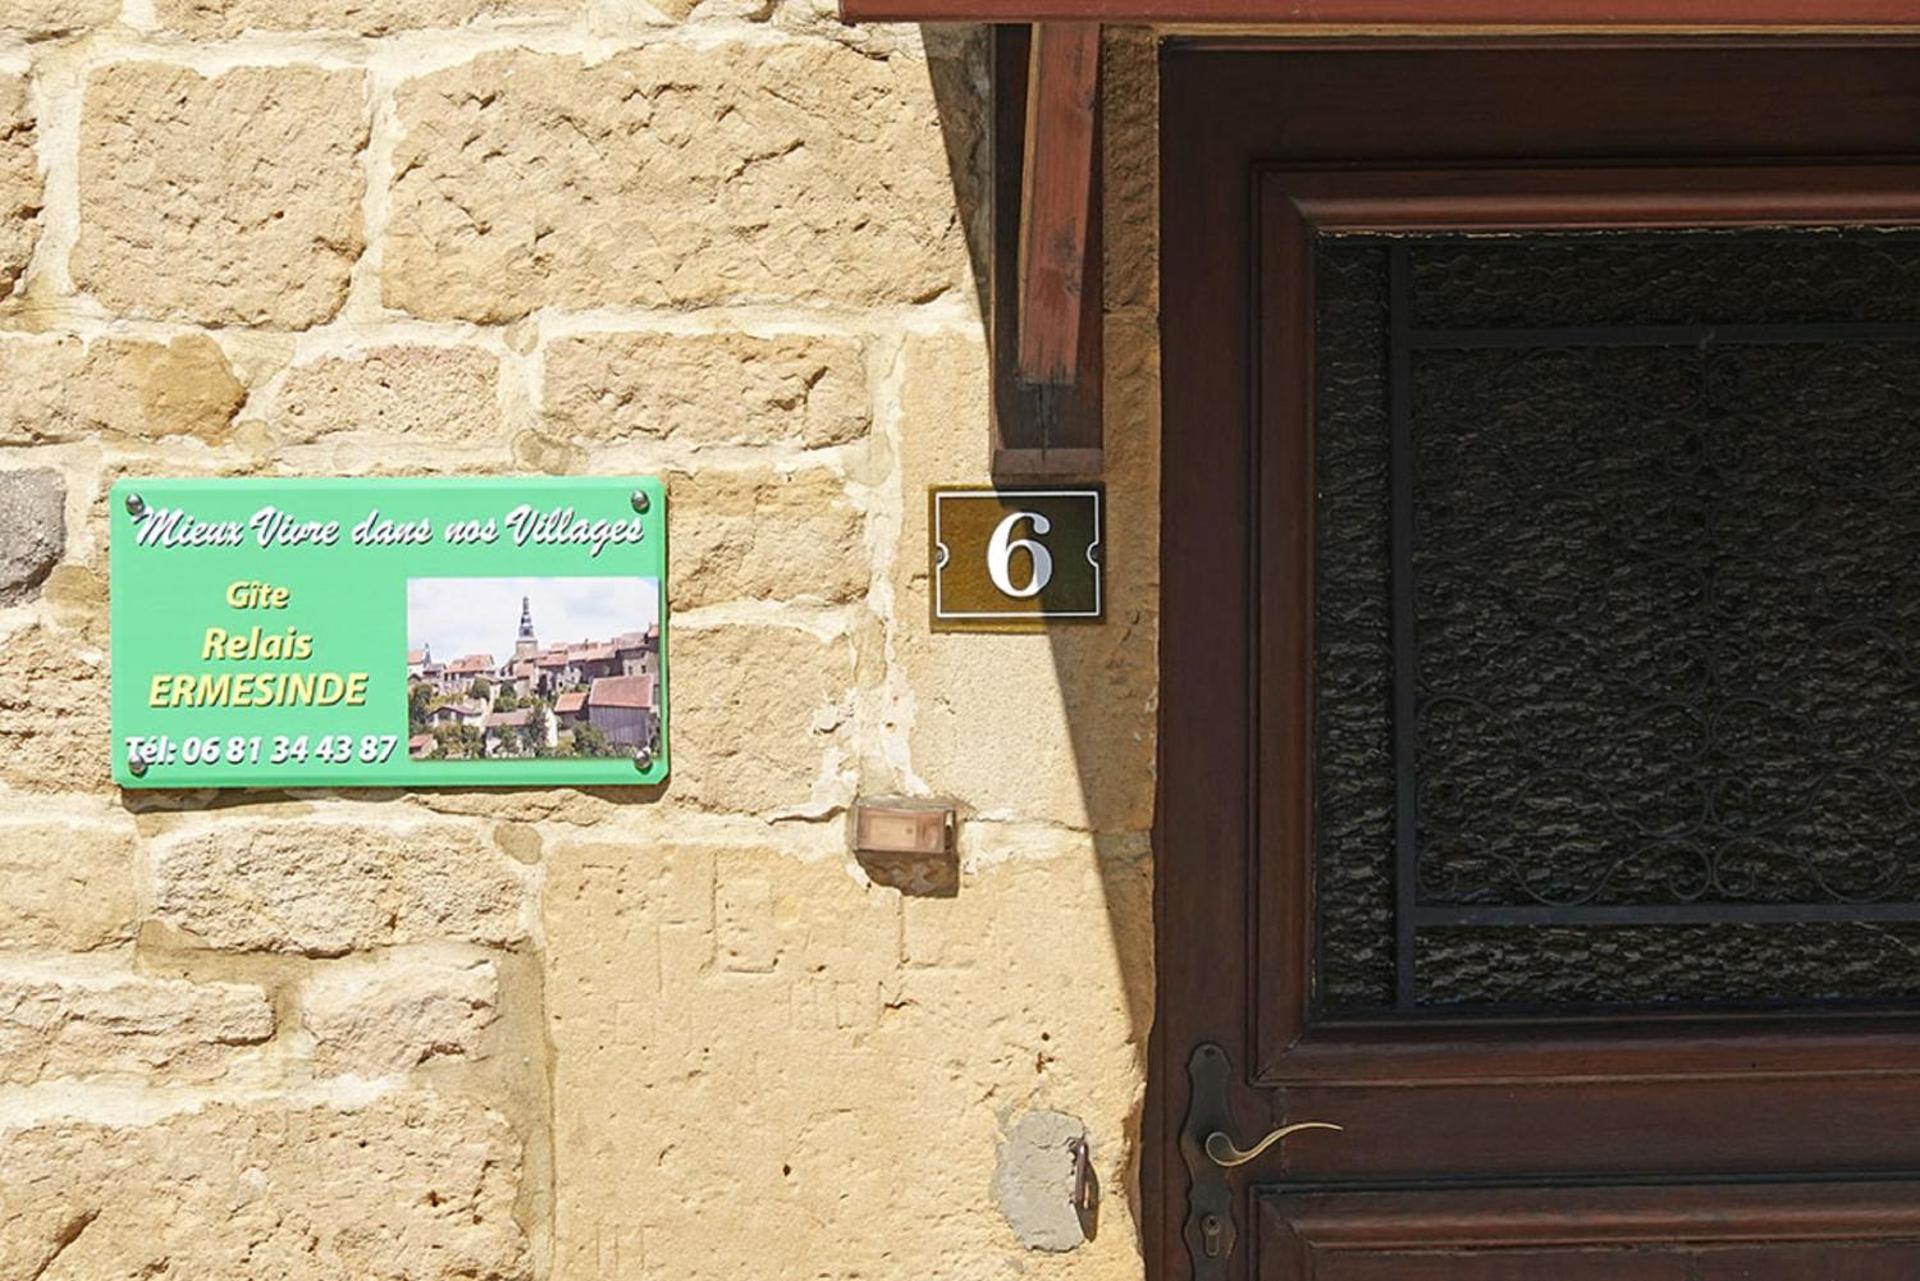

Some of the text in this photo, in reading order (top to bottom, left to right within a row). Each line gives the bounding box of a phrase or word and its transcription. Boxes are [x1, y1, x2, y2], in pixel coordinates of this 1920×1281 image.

[132, 503, 645, 557] Mieux Vivre dans nos Villages
[986, 511, 1053, 598] 6
[202, 625, 314, 661] Relais
[148, 671, 370, 708] ERMESINDE
[182, 735, 222, 765] 06
[226, 735, 263, 765] 81
[270, 735, 310, 764] 34
[314, 734, 353, 764] 43
[358, 733, 399, 764] 87
